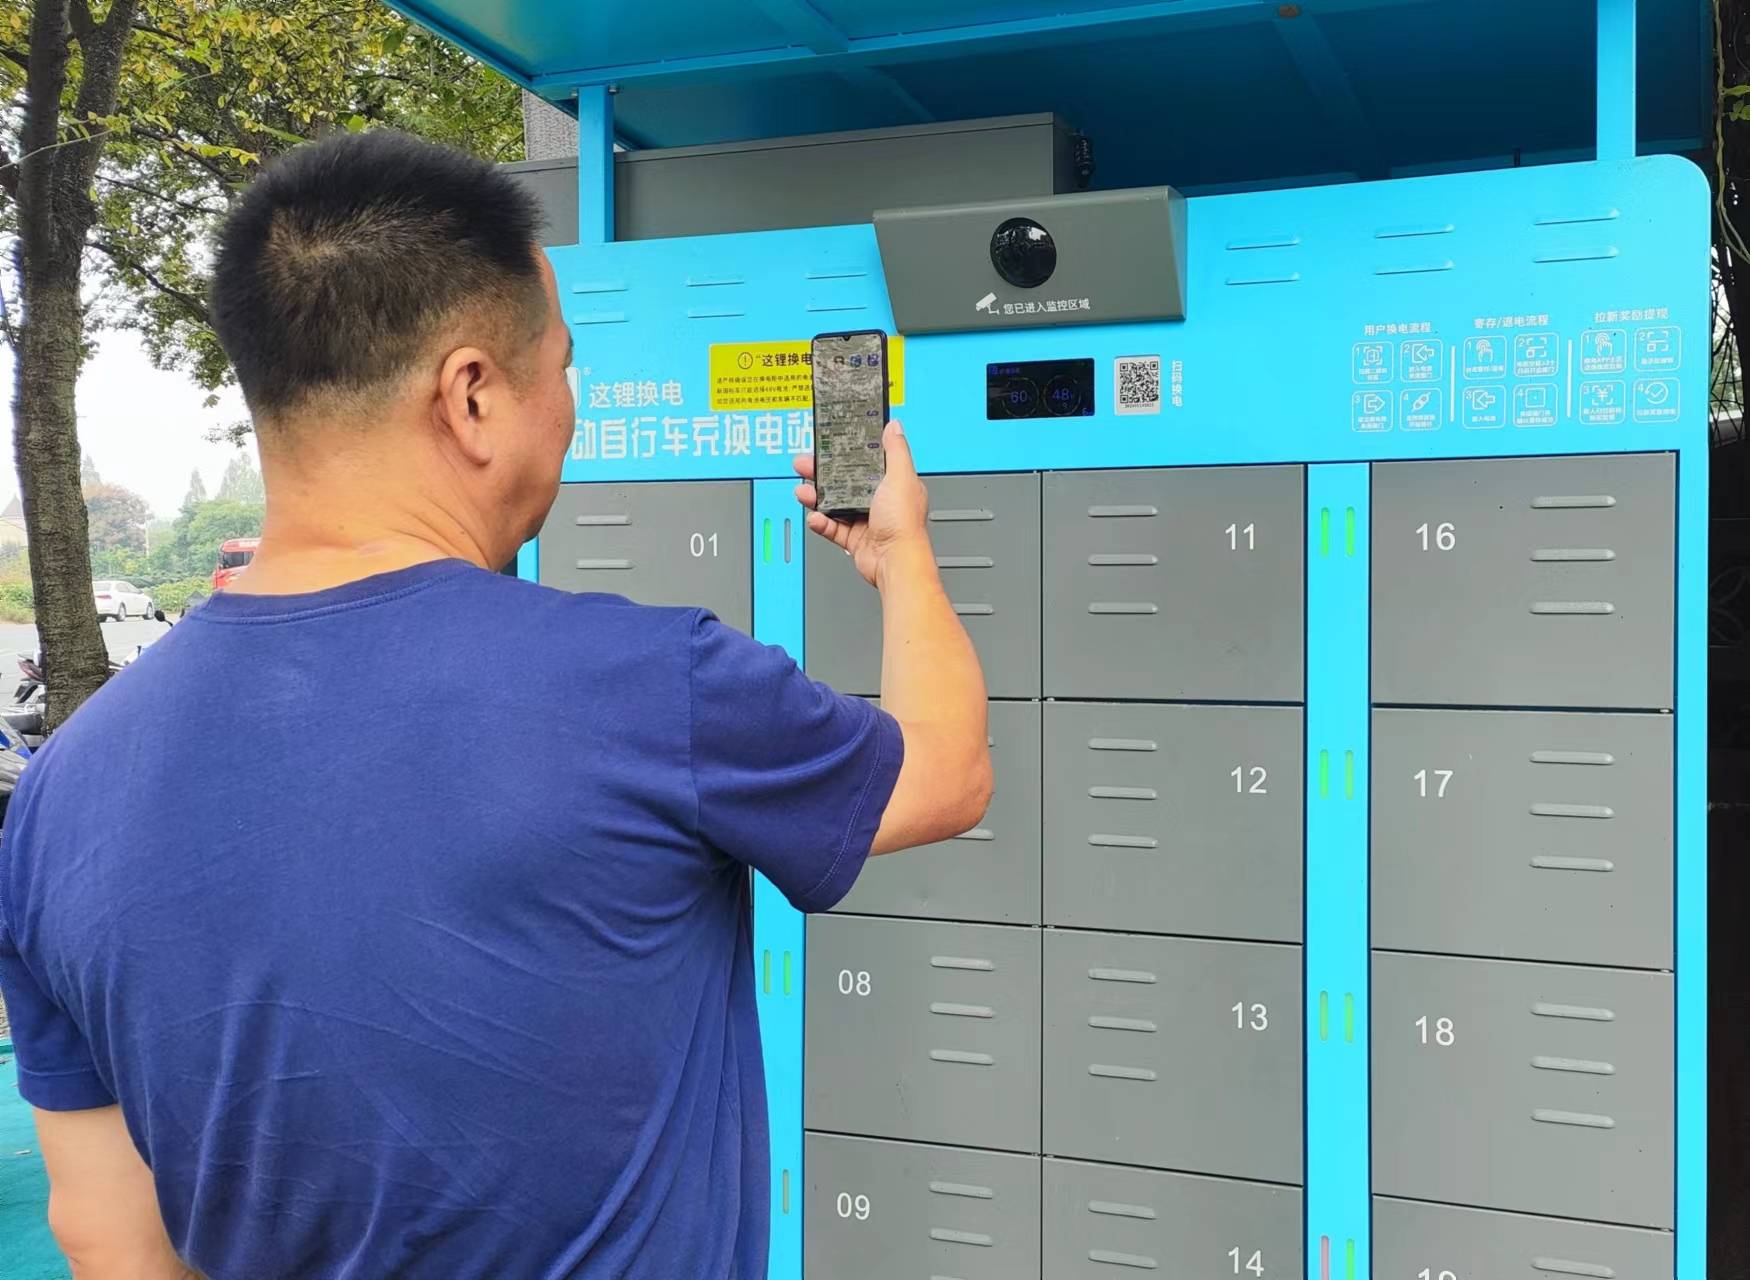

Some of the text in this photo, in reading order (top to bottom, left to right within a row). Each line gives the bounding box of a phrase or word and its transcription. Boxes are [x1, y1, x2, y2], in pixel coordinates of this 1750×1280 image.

[1003, 298, 1091, 315] 您已进入监控区域
[1595, 307, 1669, 323] 拉新奖励提现
[1364, 321, 1431, 336] 用户换电流程
[1474, 313, 1549, 329] 寄存/退电流程
[589, 379, 684, 409] 这锂换电
[690, 532, 718, 557] 01
[1225, 523, 1254, 550] 11
[1415, 522, 1456, 551] 16
[1231, 766, 1267, 794] 12
[1413, 769, 1453, 798] 17
[838, 969, 871, 996] 08
[1231, 1001, 1268, 1031] 13
[1415, 1015, 1455, 1046] 18
[837, 1192, 870, 1220] 09
[1228, 1246, 1265, 1277] 14
